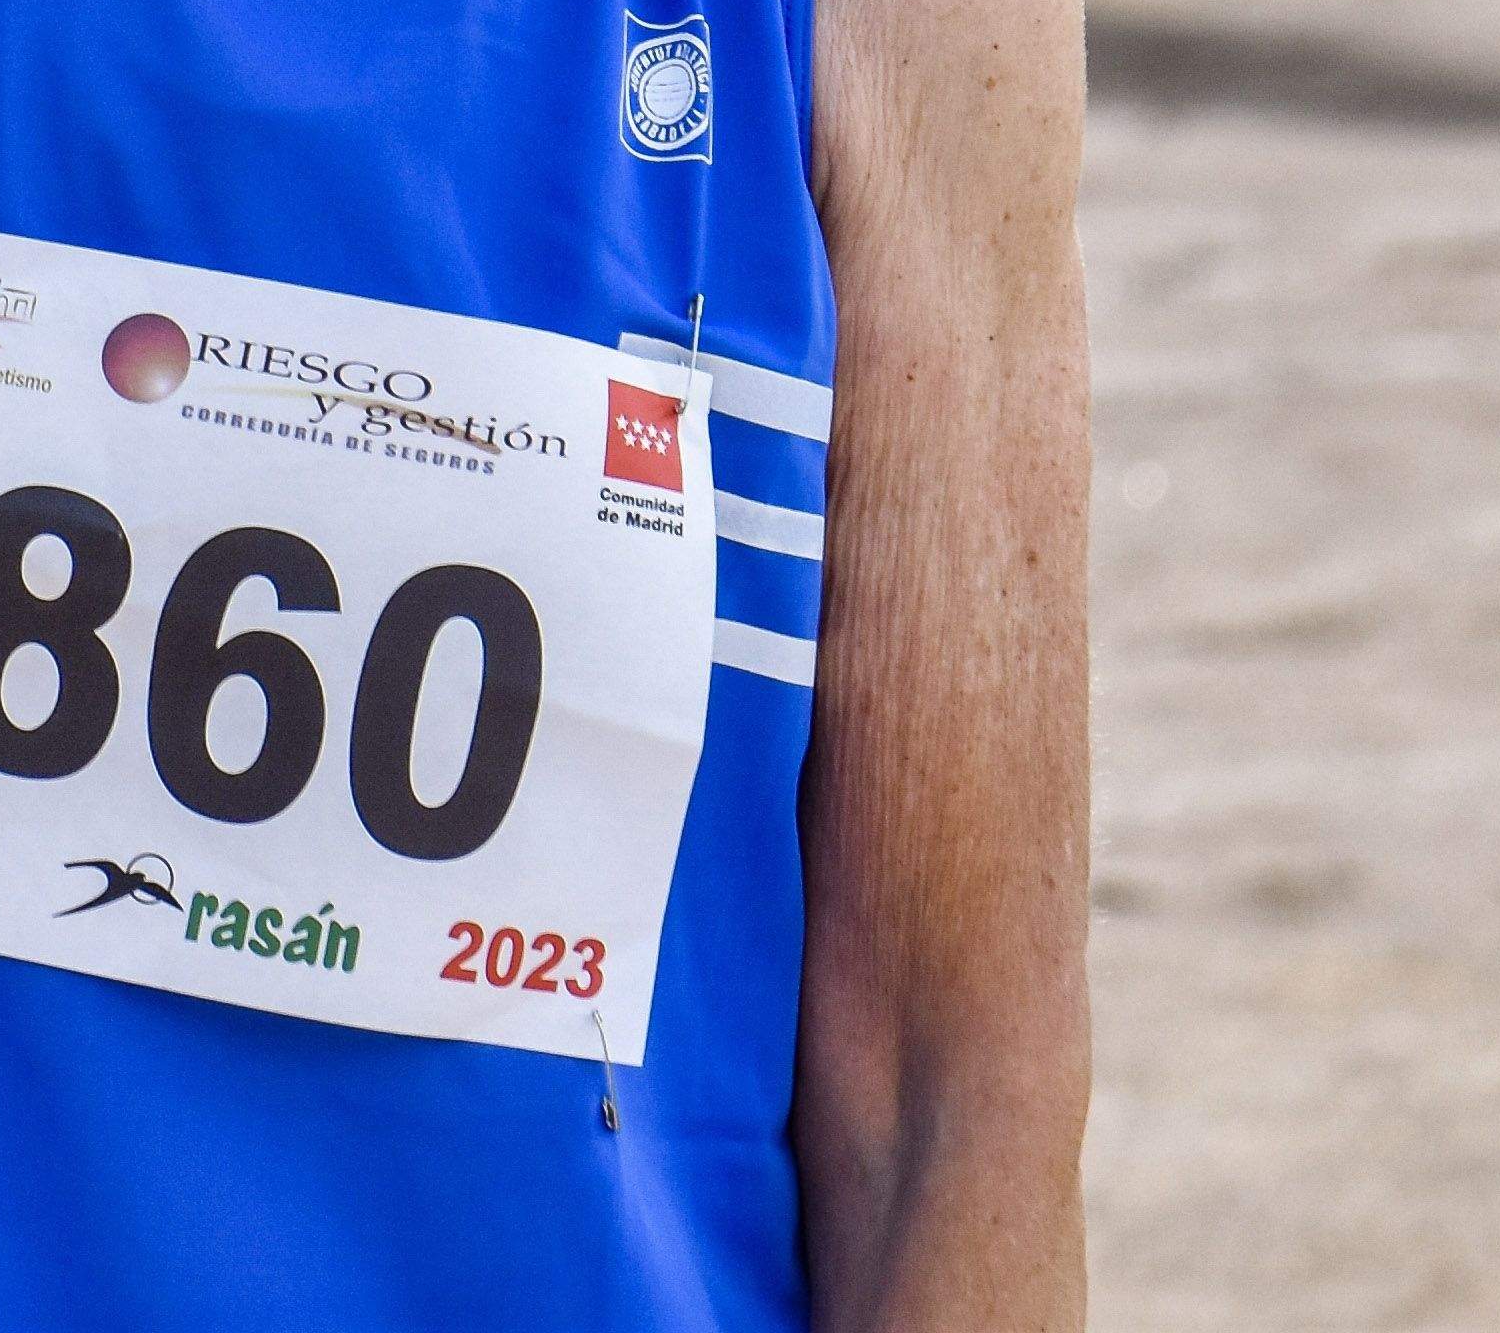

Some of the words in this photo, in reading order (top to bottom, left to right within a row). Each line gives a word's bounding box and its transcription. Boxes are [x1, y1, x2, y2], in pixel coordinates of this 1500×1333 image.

[192, 332, 433, 402] RIESGO
[309, 392, 341, 424] y
[360, 403, 568, 459] gestión
[345, 436, 373, 455] DE
[385, 442, 496, 476] SEGUROS
[597, 507, 620, 525] de
[625, 511, 684, 538] Madrid
[599, 487, 685, 518] Comunidad
[184, 889, 362, 974] rasán
[440, 919, 607, 999] 2023
